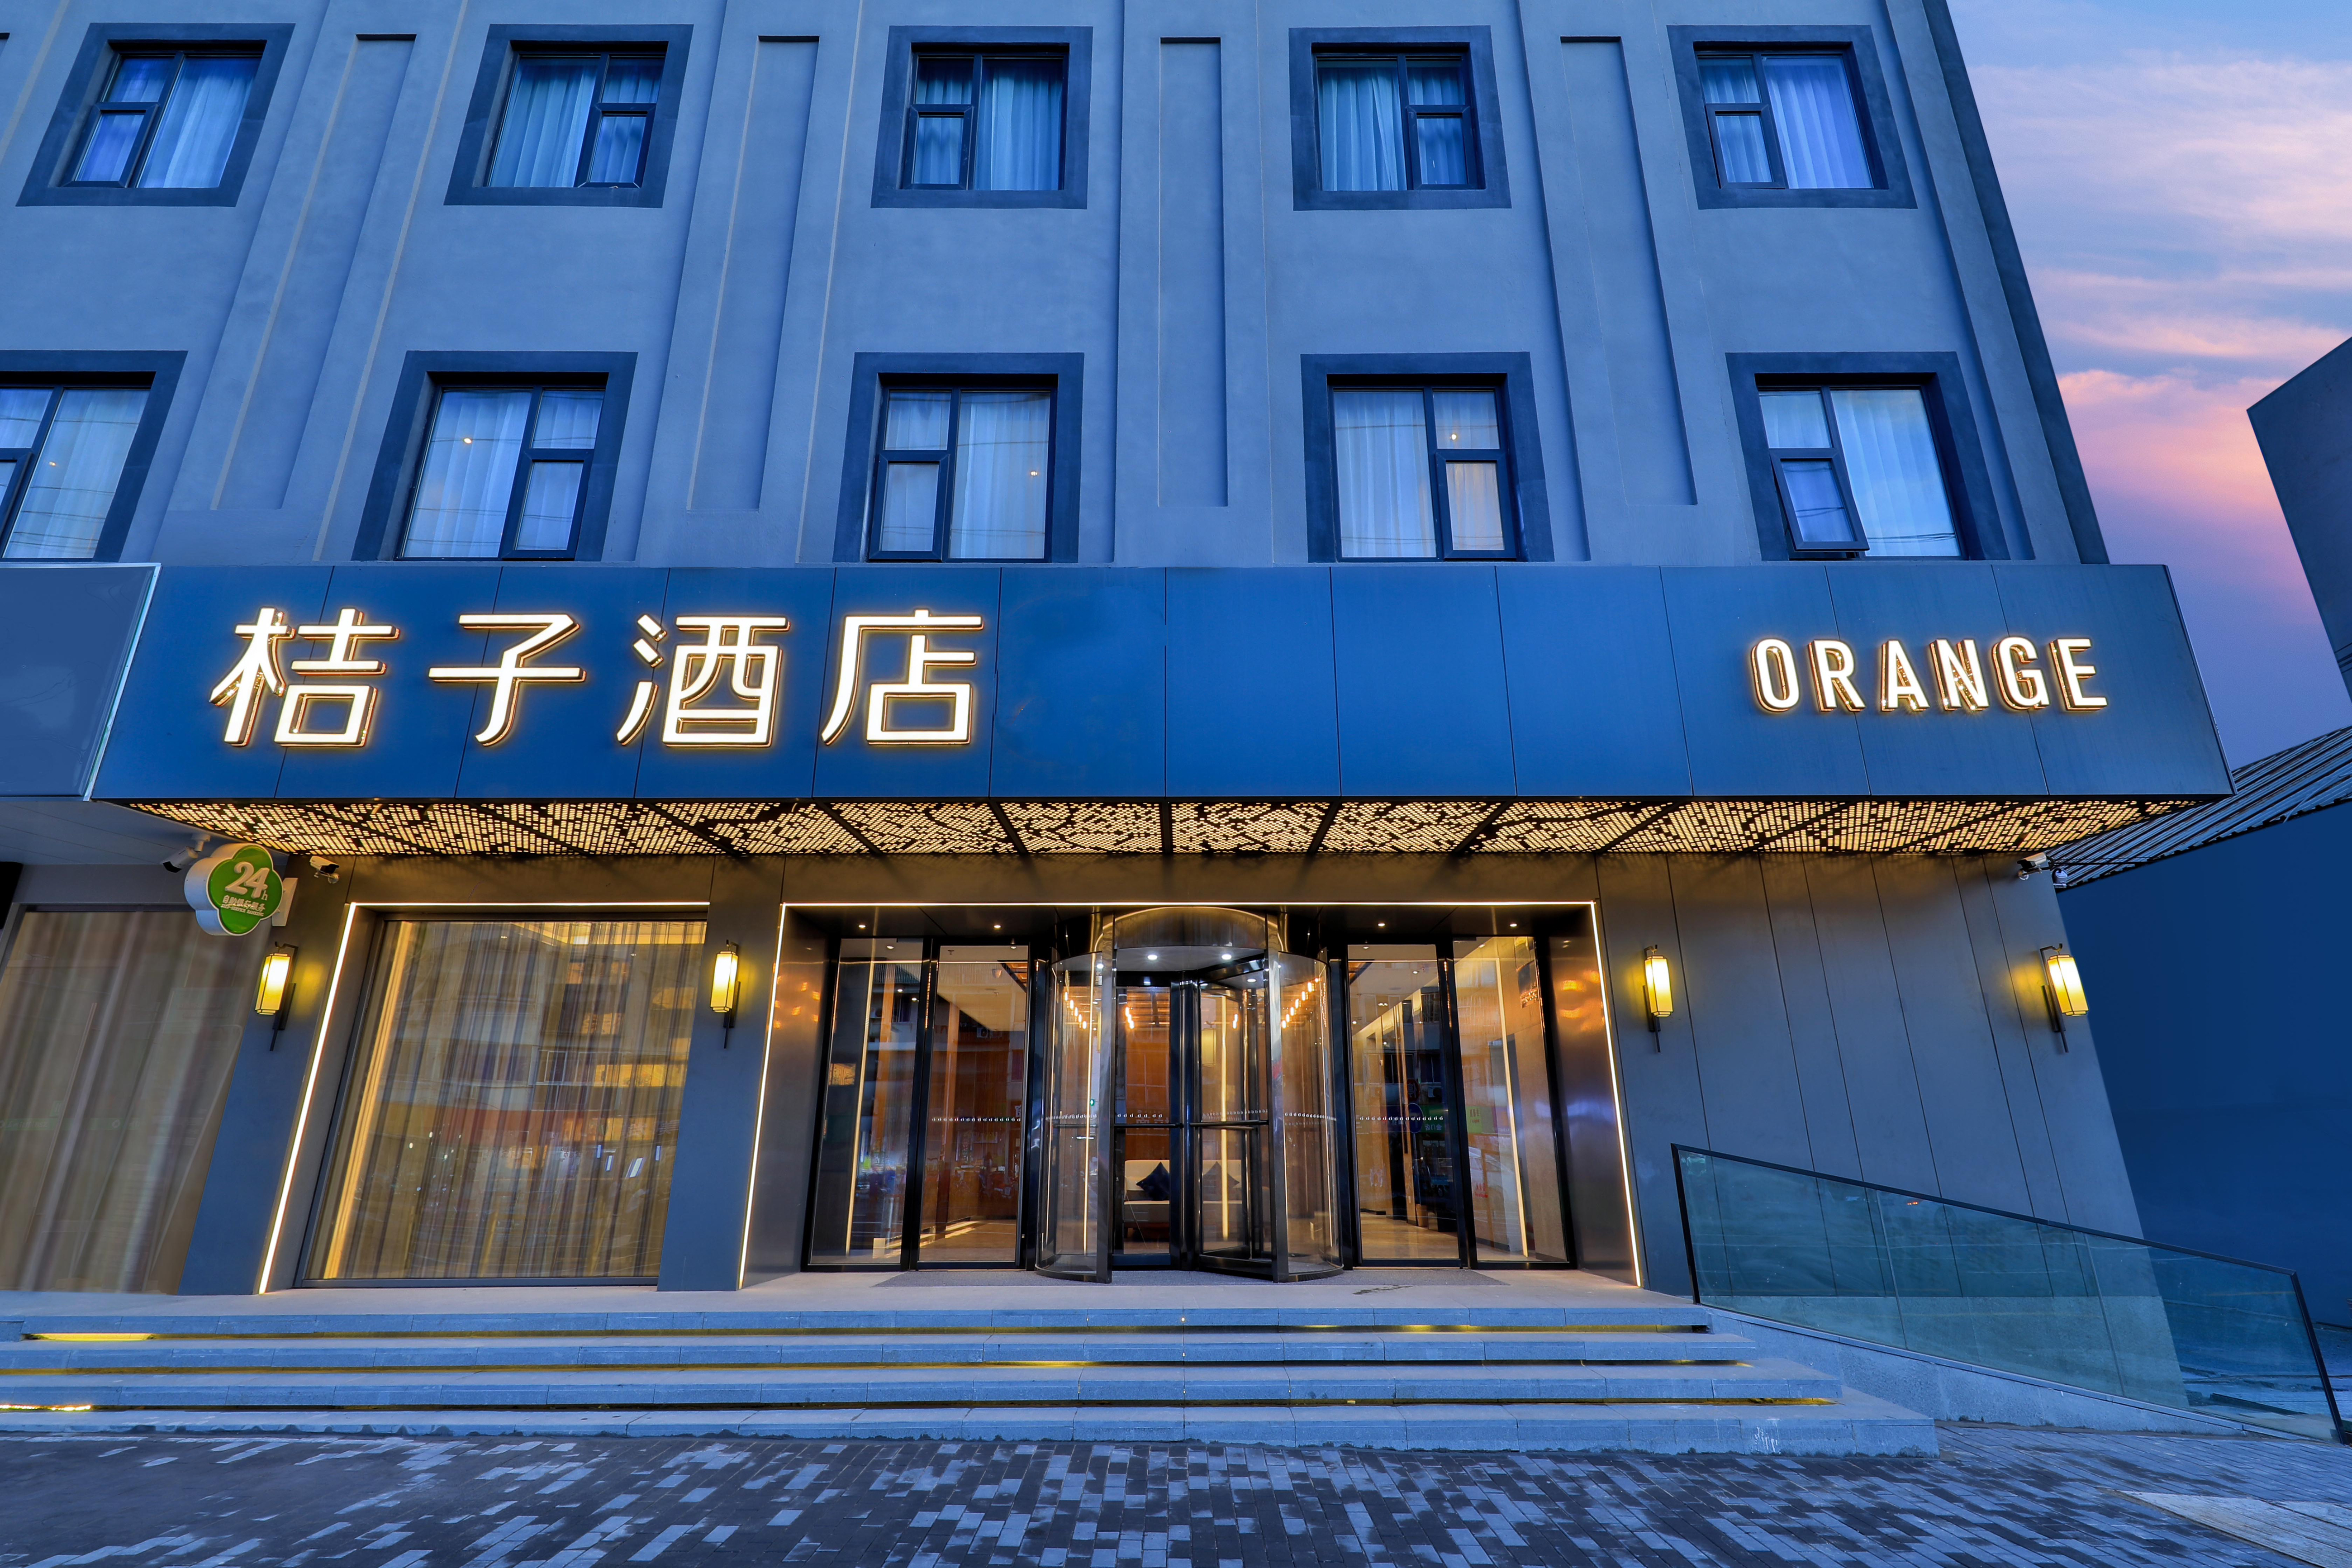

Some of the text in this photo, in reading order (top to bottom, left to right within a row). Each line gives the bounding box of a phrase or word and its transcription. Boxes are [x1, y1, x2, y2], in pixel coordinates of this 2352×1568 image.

[209, 607, 984, 747] 桔子酒店
[1751, 637, 2108, 712] ORANGE
